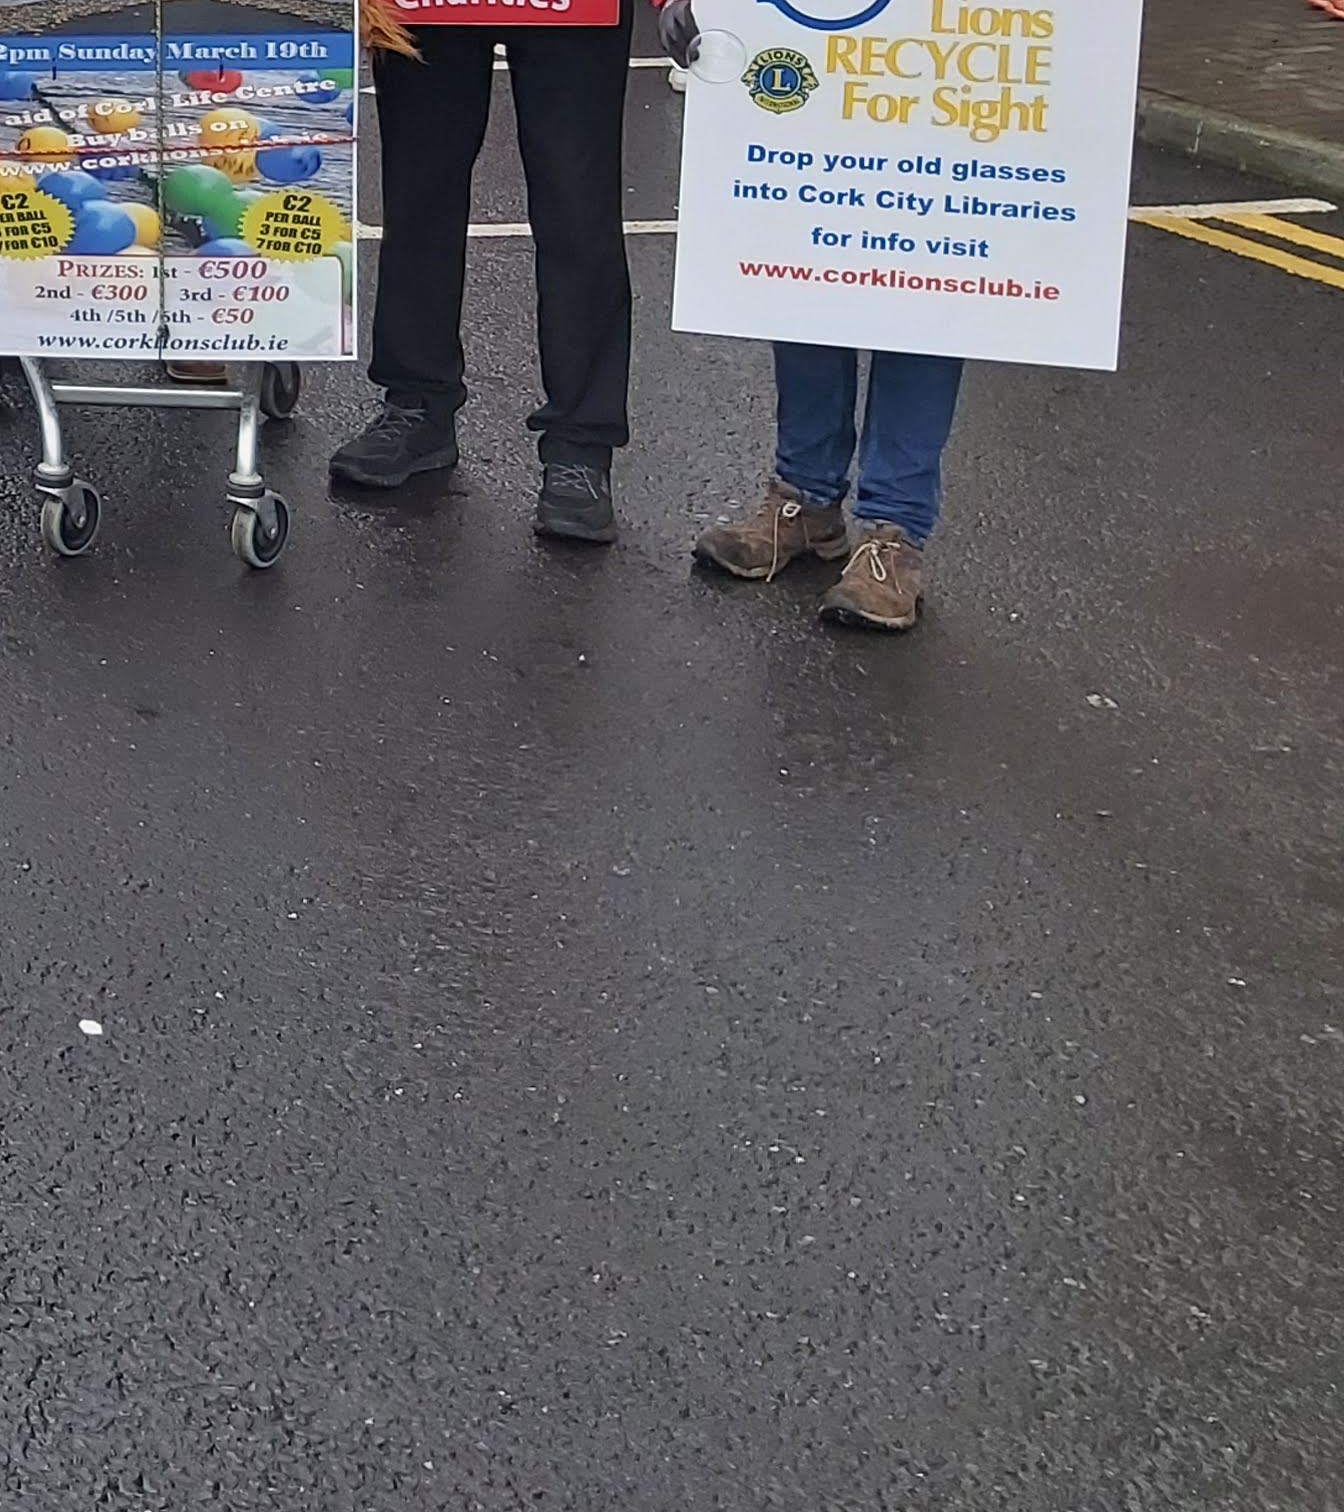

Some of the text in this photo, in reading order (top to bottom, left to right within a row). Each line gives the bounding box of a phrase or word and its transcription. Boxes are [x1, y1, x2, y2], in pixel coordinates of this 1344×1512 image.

[58, 42, 157, 63] Sunday
[165, 42, 257, 61] March
[267, 42, 327, 59] 19th
[760, 49, 805, 66] LIONS
[825, 34, 1054, 86] RECYCLE
[172, 78, 336, 108] Life Centre
[842, 82, 1048, 143] For Sight
[747, 144, 1067, 185] Drop your old glasses
[283, 194, 310, 213] €2
[733, 180, 1077, 222] into Cork City Libraries
[812, 227, 990, 259] for info visit
[57, 259, 267, 280] PRIZES: €500
[739, 259, 1061, 301] www.corklionsclub.ie
[91, 284, 289, 302] €300 €100
[212, 308, 254, 324] €50
